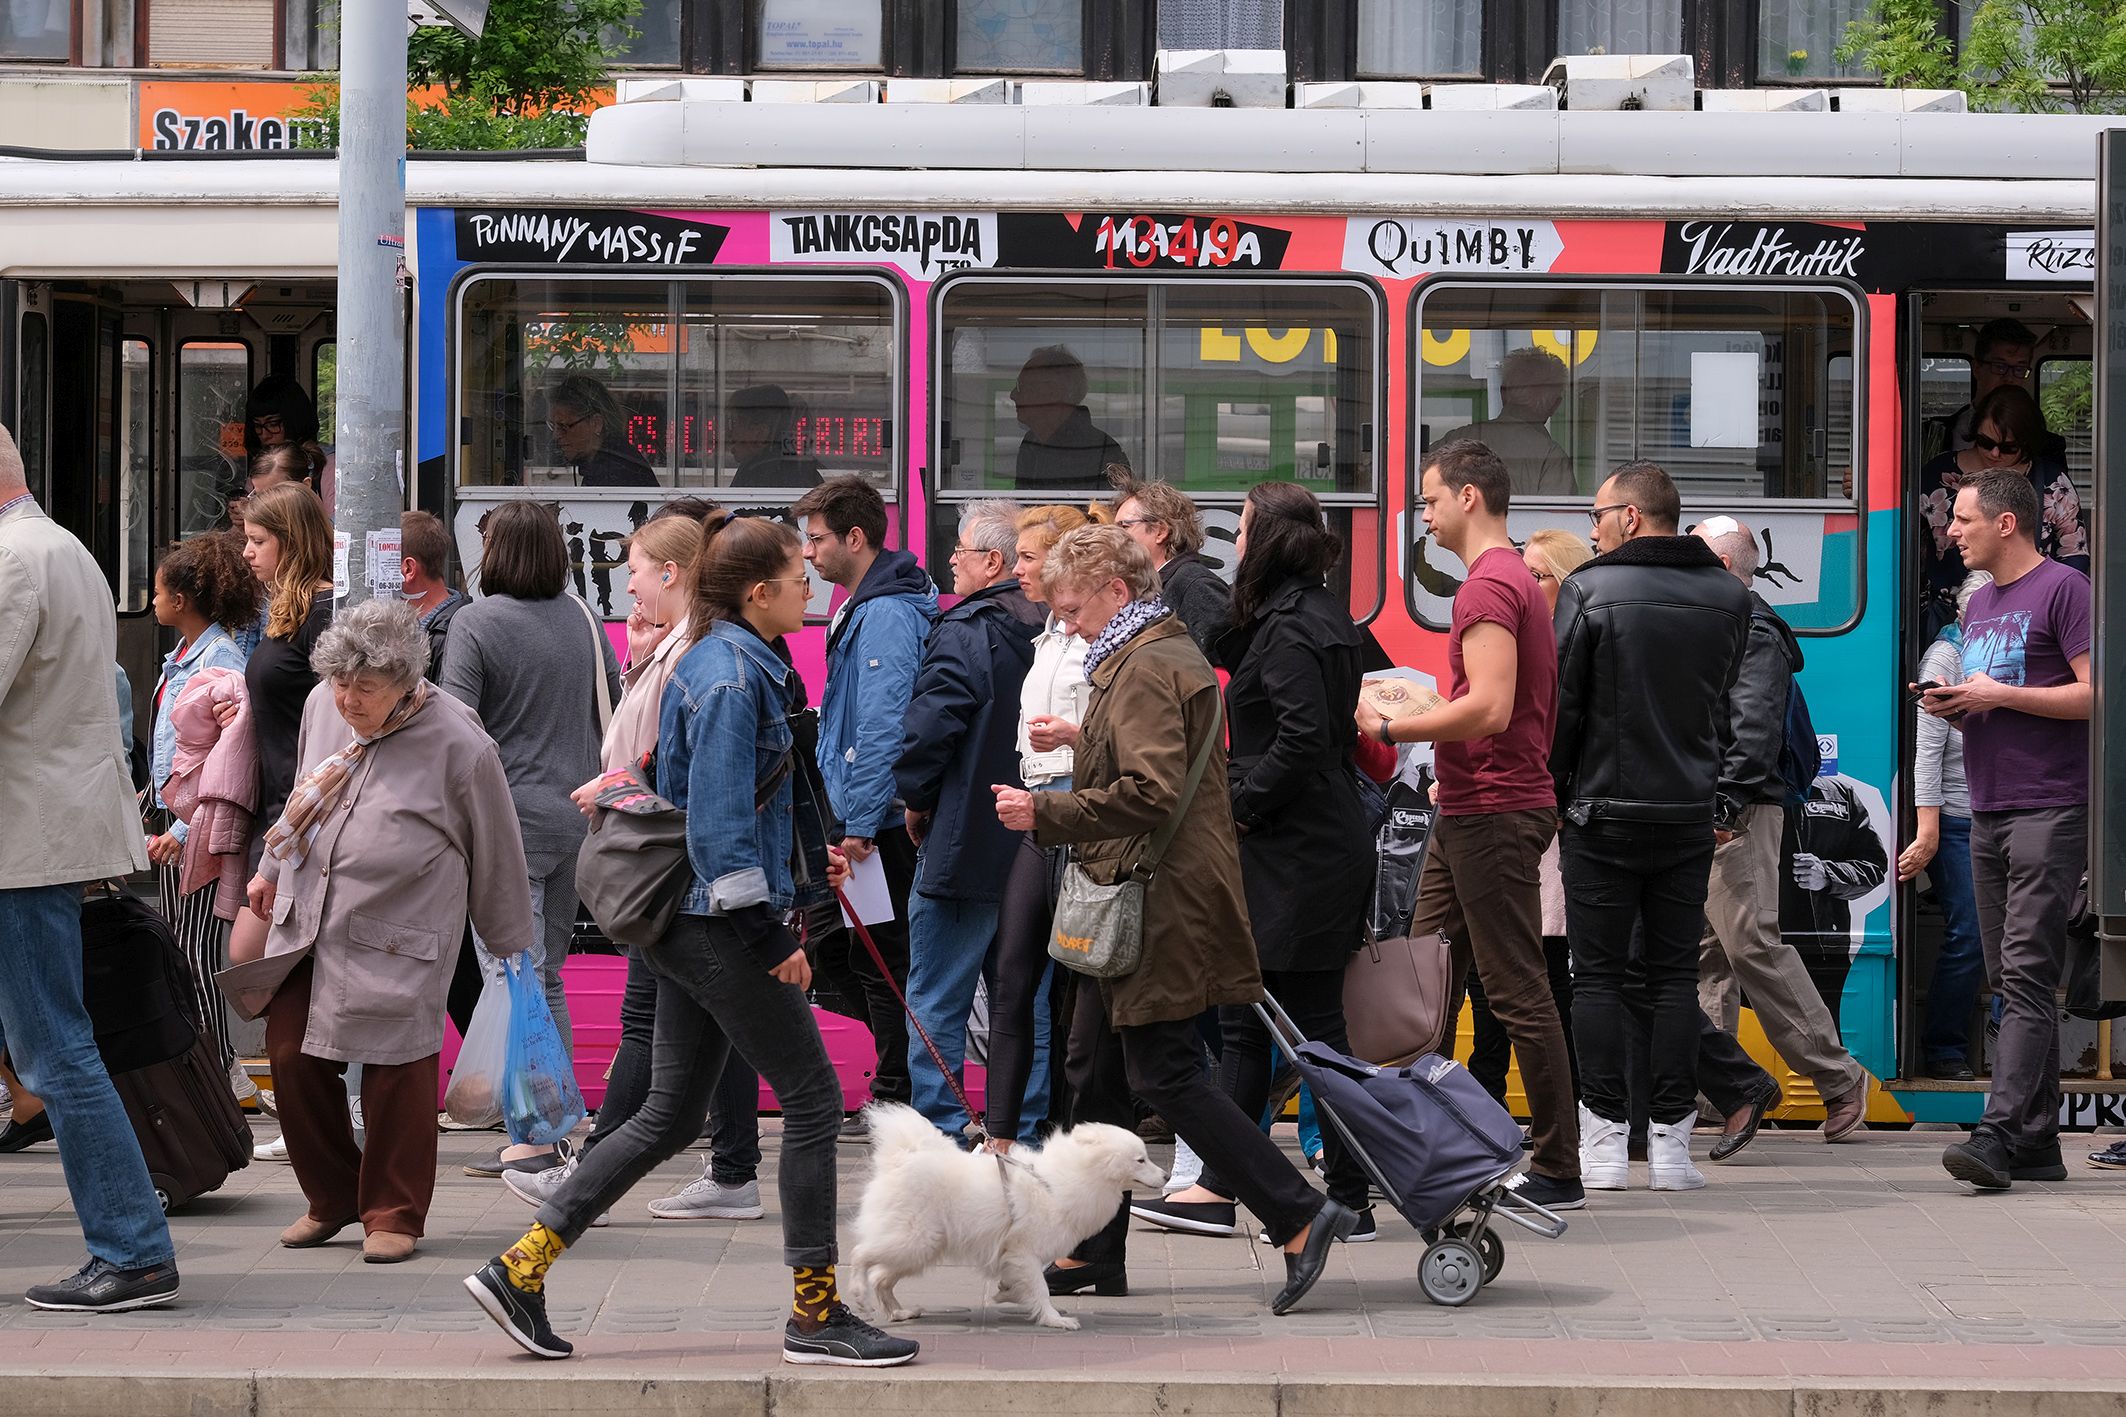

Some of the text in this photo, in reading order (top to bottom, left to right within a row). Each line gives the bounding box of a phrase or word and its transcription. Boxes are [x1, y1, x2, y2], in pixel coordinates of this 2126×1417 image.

[786, 40, 843, 49] www.topal.hu
[782, 215, 981, 275] TANKCSAPDA
[1097, 215, 1238, 268] 1349
[2059, 1093, 2126, 1126] PR
